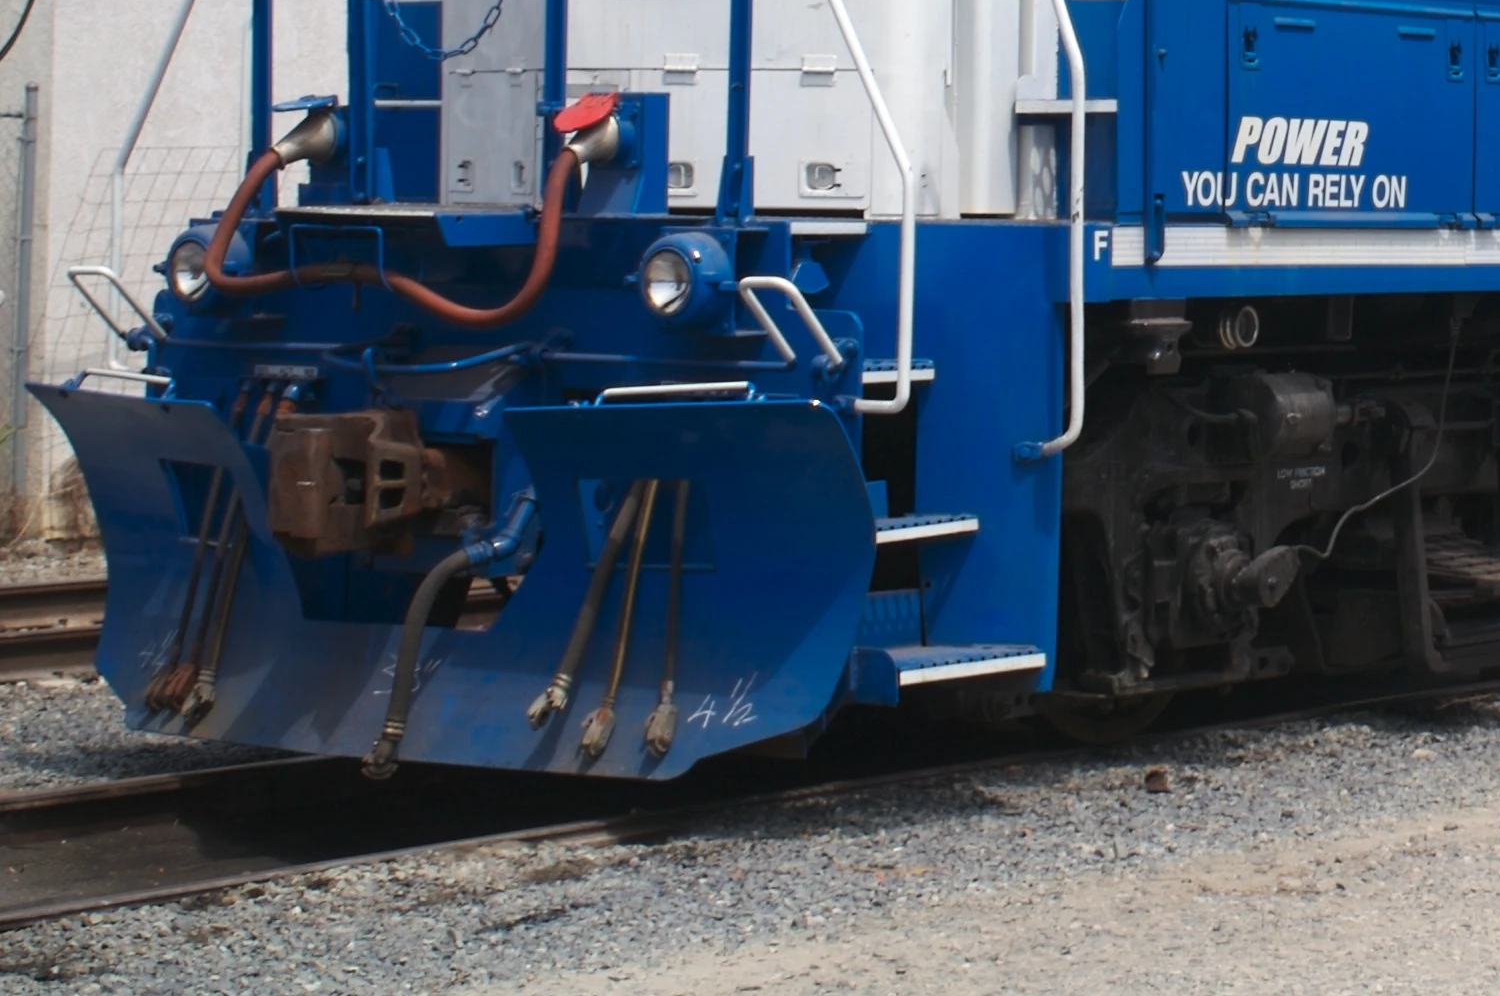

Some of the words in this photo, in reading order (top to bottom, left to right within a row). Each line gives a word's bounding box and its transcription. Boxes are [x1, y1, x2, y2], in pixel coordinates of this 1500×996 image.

[1230, 116, 1370, 167] POWER
[1181, 170, 1236, 208] YOU
[1245, 172, 1298, 208] CAN
[1308, 173, 1365, 208] RELY
[1371, 174, 1406, 209] ON
[1093, 230, 1109, 262] F
